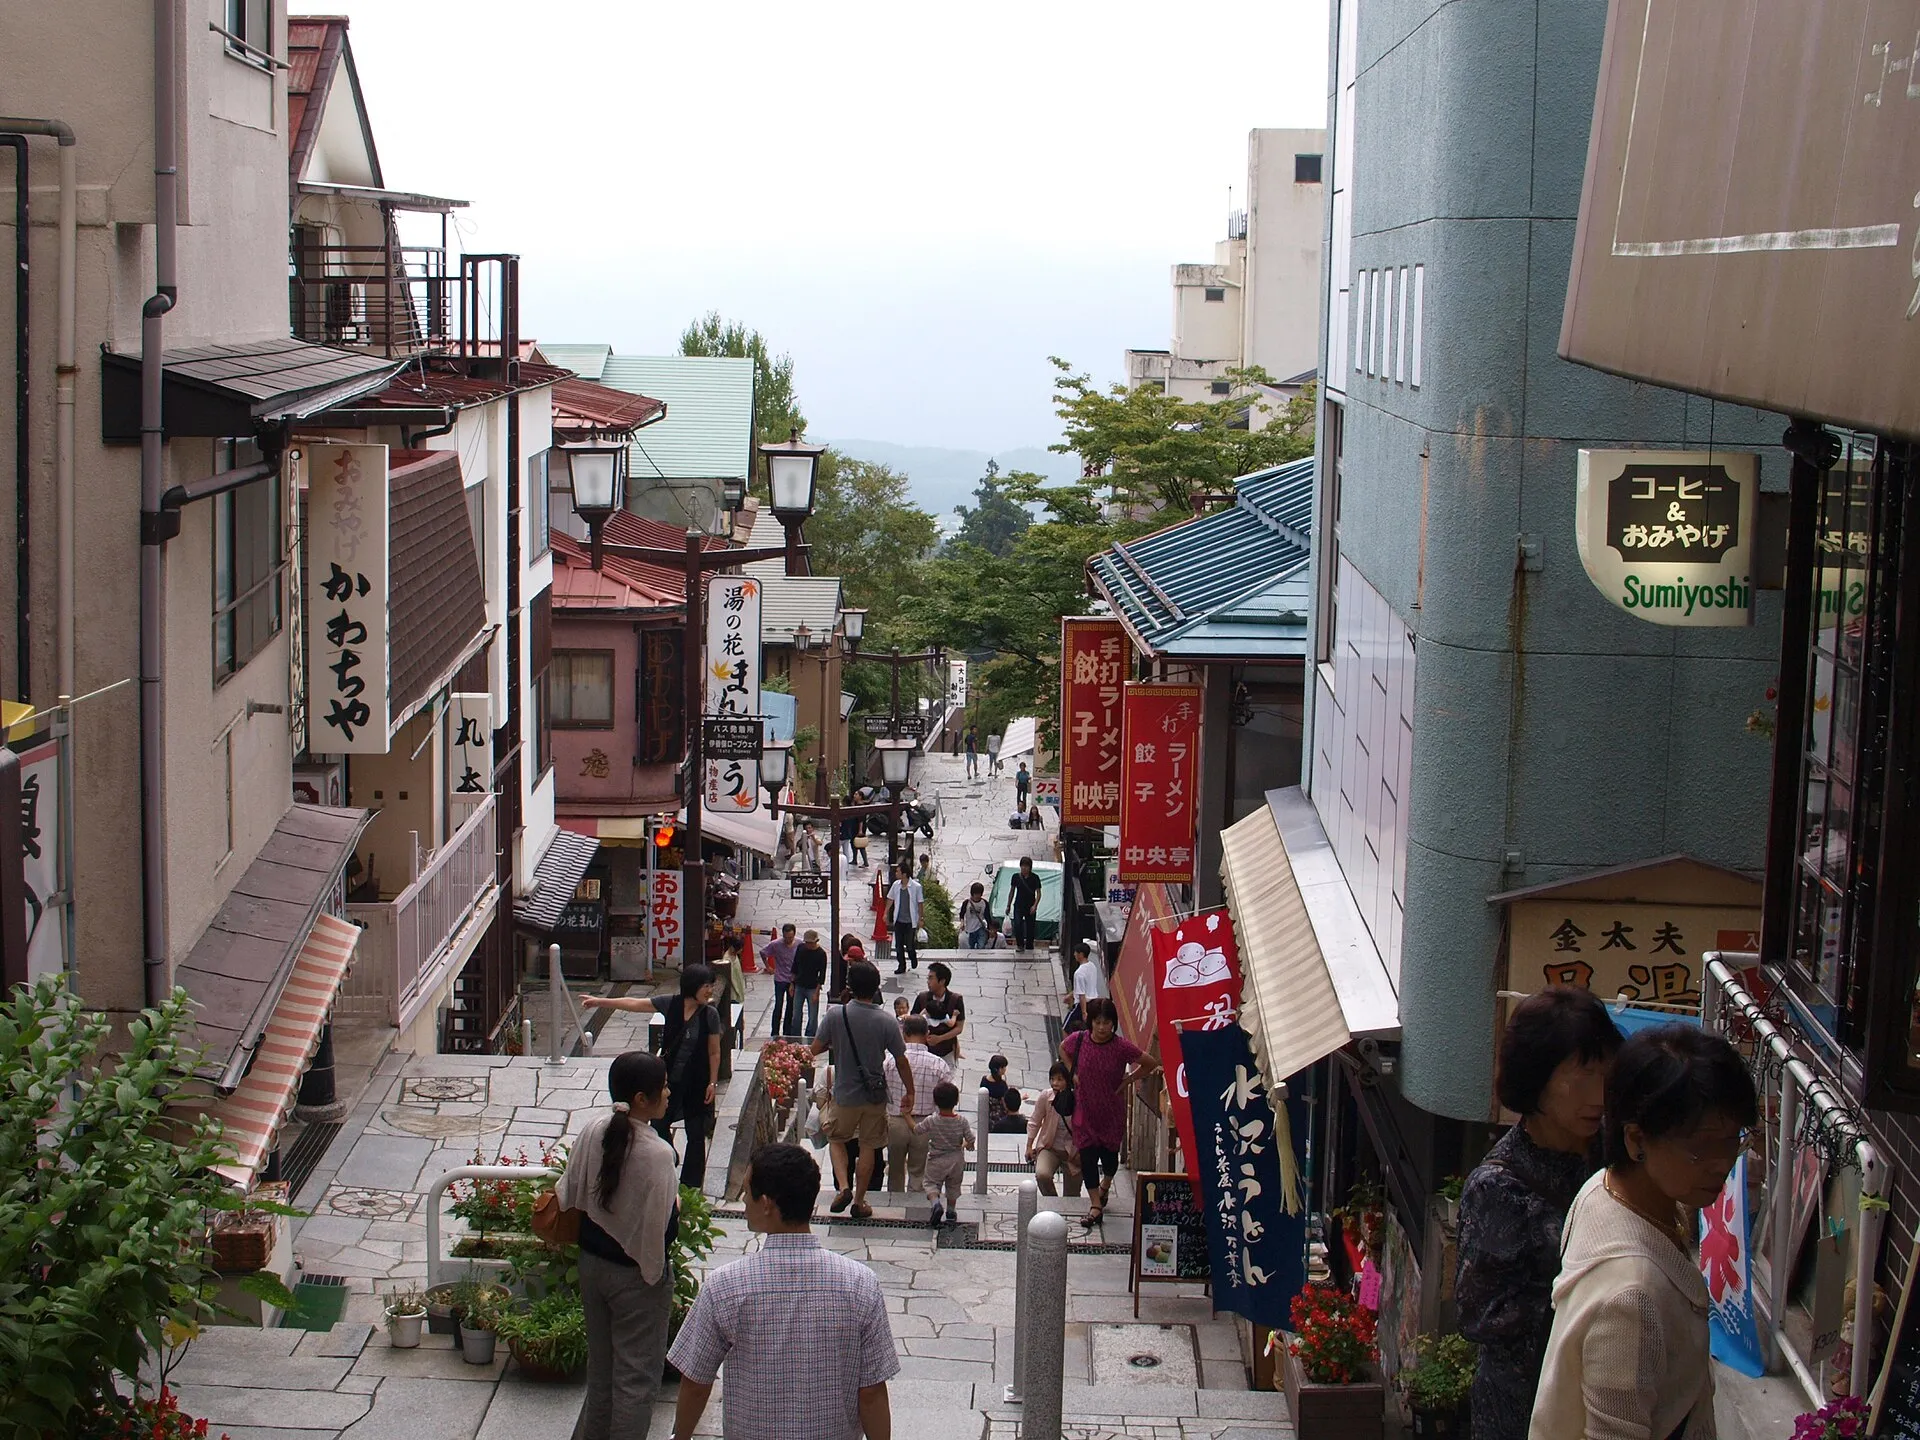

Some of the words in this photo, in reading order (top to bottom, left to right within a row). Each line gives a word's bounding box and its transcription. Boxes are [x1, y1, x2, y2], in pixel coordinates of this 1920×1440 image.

[333, 450, 368, 563] おみやげ
[1631, 476, 1722, 500] コーヒー
[1667, 501, 1685, 521] &
[1622, 523, 1729, 548] おみやげ
[1622, 575, 1749, 616] Sumiyoshi
[320, 561, 371, 742] かわちや
[1072, 650, 1099, 747] 餃子
[1099, 637, 1120, 771] 手打ラーメン
[1161, 702, 1193, 734] 手打
[708, 759, 719, 803] 物産店
[1134, 743, 1155, 802] 餃子
[1165, 743, 1187, 818] ラーメン
[1125, 845, 1190, 866] 中央亭
[652, 872, 680, 960] おみやげ
[1550, 918, 1686, 955] 金太夫
[1219, 1064, 1276, 1287] 水沢うどん
